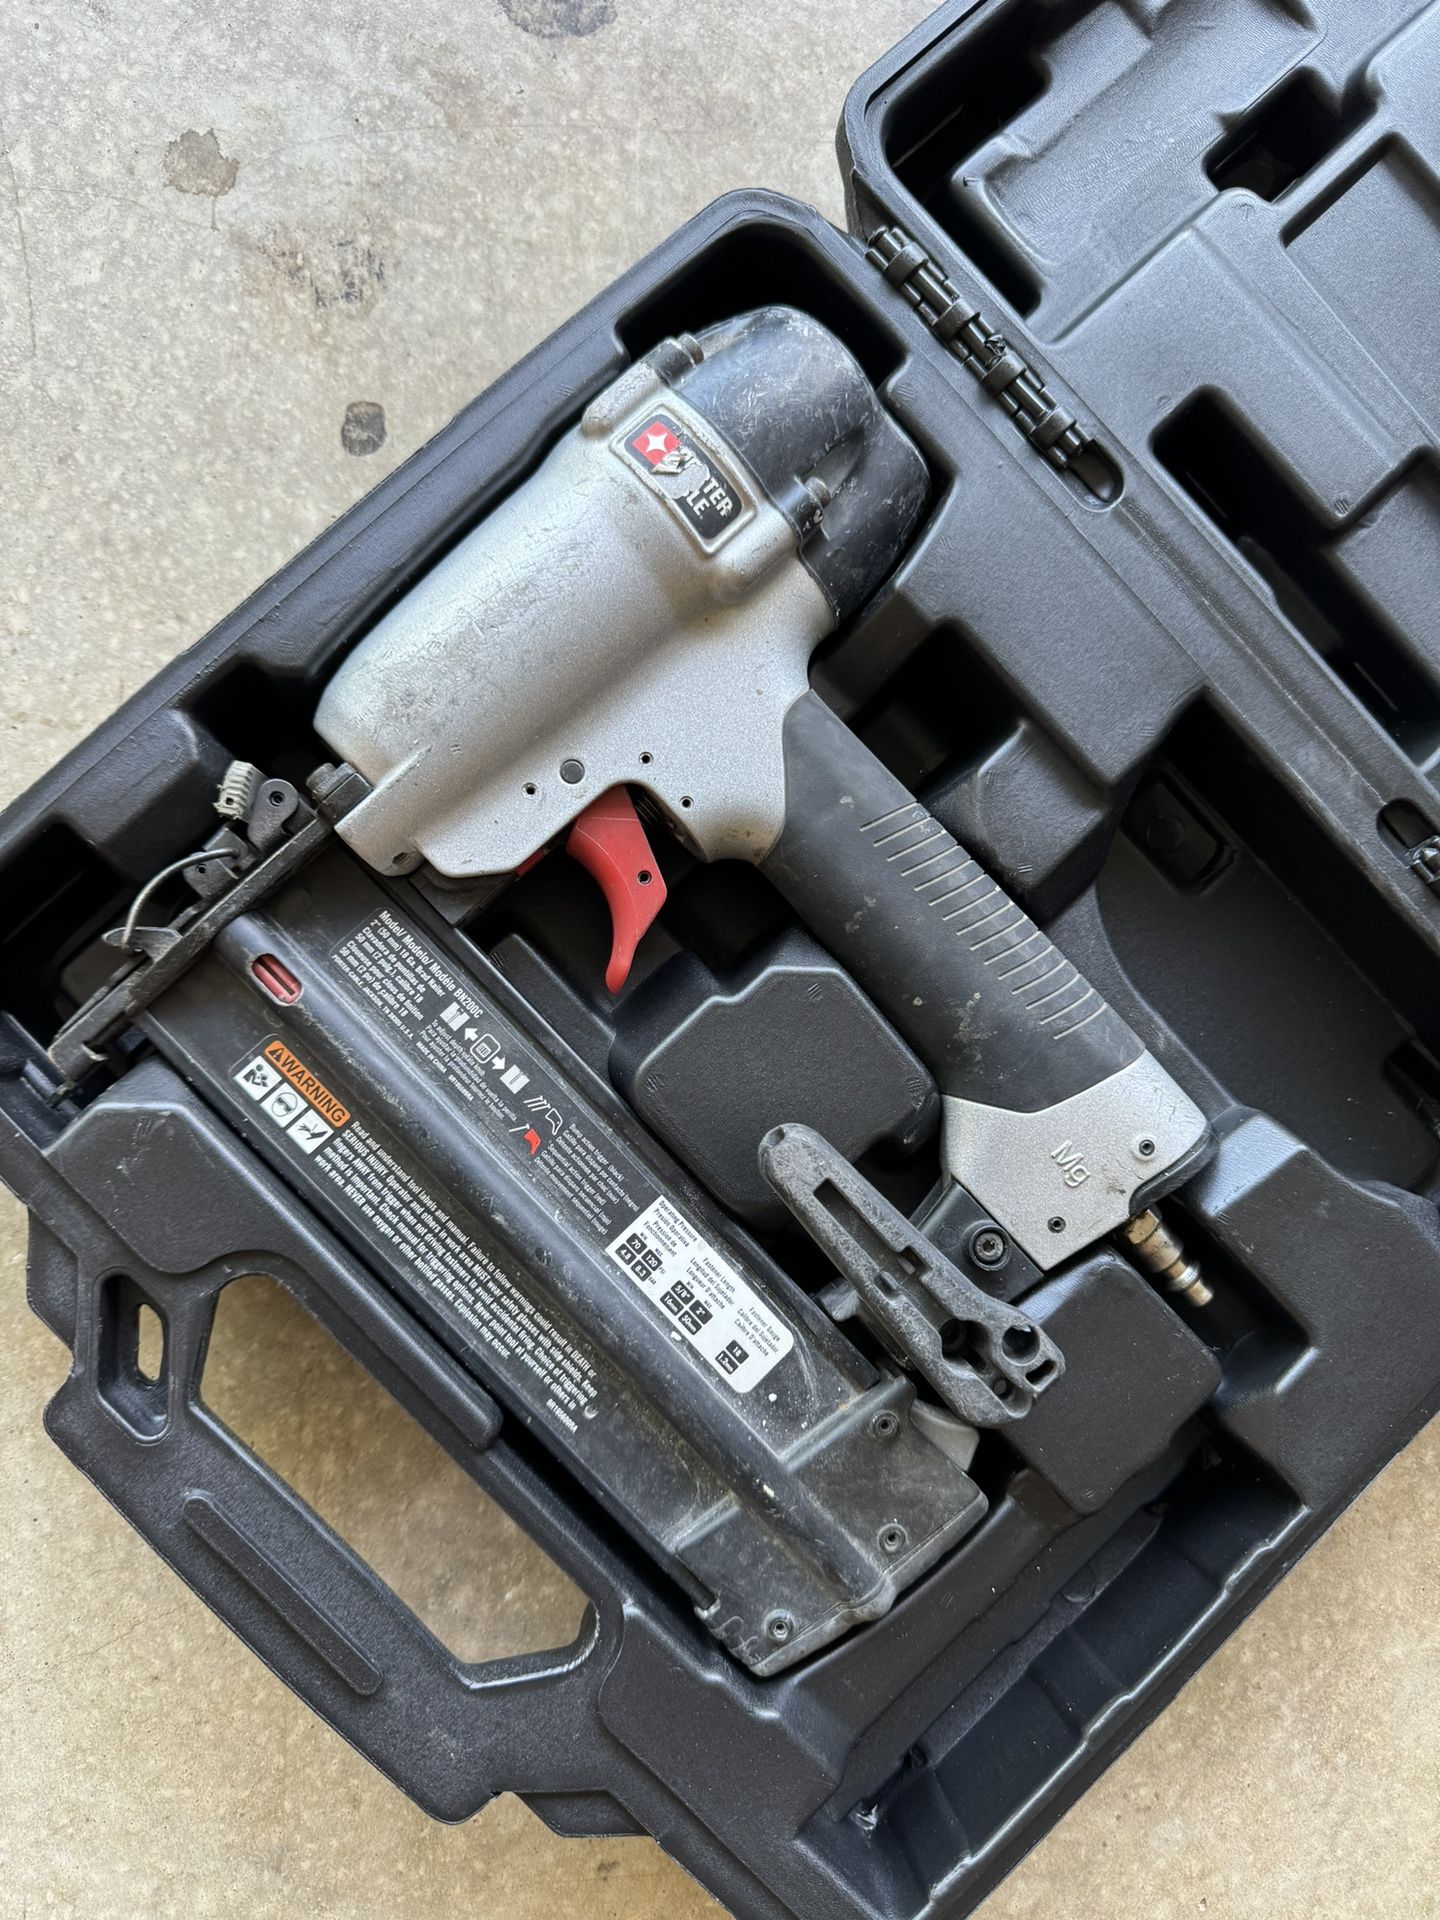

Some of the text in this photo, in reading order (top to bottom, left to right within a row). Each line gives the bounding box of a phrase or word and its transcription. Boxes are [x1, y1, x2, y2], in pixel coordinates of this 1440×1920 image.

[338, 946, 408, 1017] 50 mm (2 po) de calibre 18
[345, 939, 424, 1021] Cloueuse pour clous de finition
[354, 932, 424, 1003] 50 mm (2 pulg.), calibre 18
[361, 926, 426, 993] Clavadora de puntillas de
[377, 926, 390, 939] (50
[386, 936, 402, 952] mm)
[398, 948, 409, 959] 18
[405, 955, 417, 968] Ga.
[414, 964, 431, 982] Brad
[427, 978, 446, 997] Nailer
[378, 910, 407, 937] Model/
[401, 934, 434, 965] Modelo/
[453, 987, 483, 1018] BN200C
[361, 985, 384, 1008] JACKSON,
[381, 1005, 391, 1014] TN
[399, 1024, 414, 1040] U.S.A.
[415, 1041, 430, 1055] MADE
[432, 1058, 447, 1073] CHINA
[280, 1054, 346, 1123] WARNING
[547, 1143, 607, 1206] Sequential action trigger (red)
[568, 1122, 624, 1182] Bump action trigger (black)
[1050, 1140, 1090, 1188] Mg
[350, 1120, 597, 1379] Read and understand tool labels and manual. Failure to follow warnings could result in DEATH or
[643, 1220, 677, 1257] Fonctionnement
[652, 1220, 677, 1247] Pression de
[658, 1200, 698, 1242] Operating Pressure
[668, 1224, 690, 1247] Operativa
[313, 1154, 511, 1359] work area. NEVER use oxygen or other bottled gasses. Explosion may occur.
[323, 1145, 577, 1410] method is important. Check manual for triggering options. Never point tool at yourself or others in
[332, 1136, 588, 1406] fingers AWAY from trigger when not driving fasteners to avoid accidental firing. Choice of triggering
[341, 1128, 598, 1398] SERIOUS INJURY. Operator and others in work area MUST wear safety glasses with side shields. Keep
[619, 1248, 646, 1277] 4.8 8.3
[631, 1238, 658, 1267] 70 120
[702, 1257, 736, 1293] Fastener Length
[663, 1294, 697, 1332] 16mm 50mm
[674, 1284, 706, 1316] 5/8" 2"
[748, 1306, 768, 1328] Fastener
[717, 1352, 734, 1372] 1.2mm
